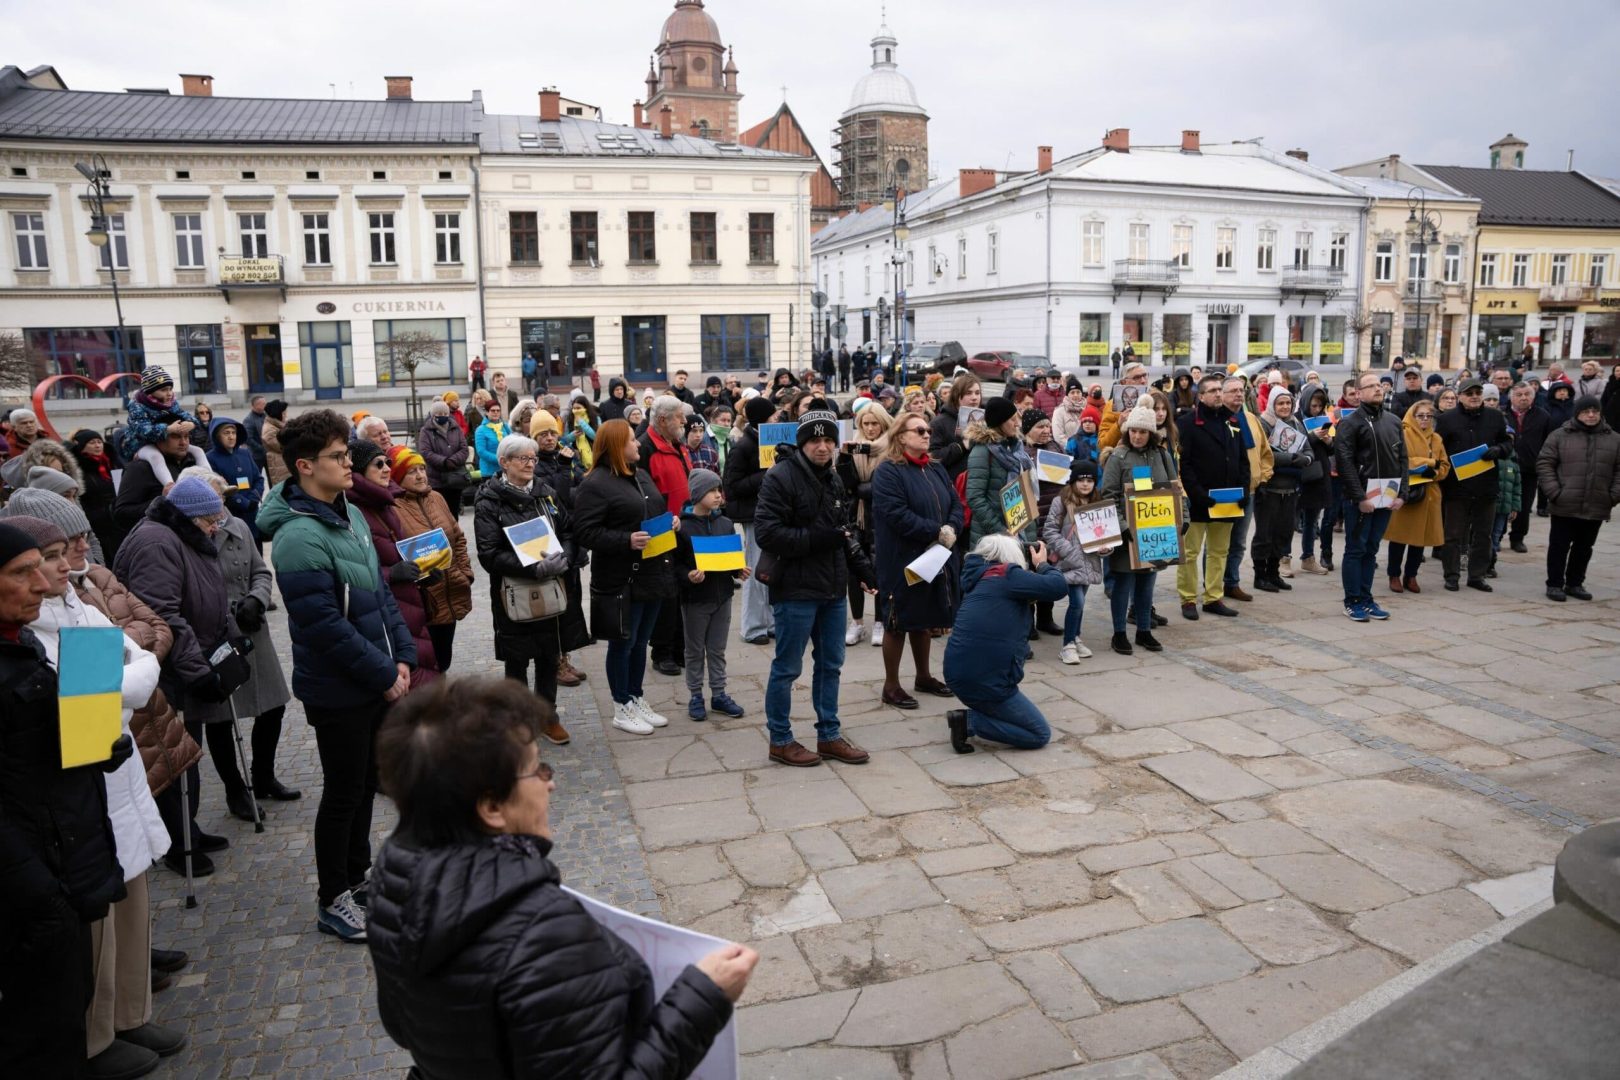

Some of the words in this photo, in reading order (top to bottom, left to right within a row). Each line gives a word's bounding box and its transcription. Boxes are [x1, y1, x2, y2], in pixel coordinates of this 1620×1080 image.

[352, 300, 446, 313] CUKIERNIA
[1010, 505, 1021, 517] GO
[1079, 506, 1116, 524] PUTIN
[1136, 501, 1172, 519] Putin
[1010, 509, 1029, 530] HOME
